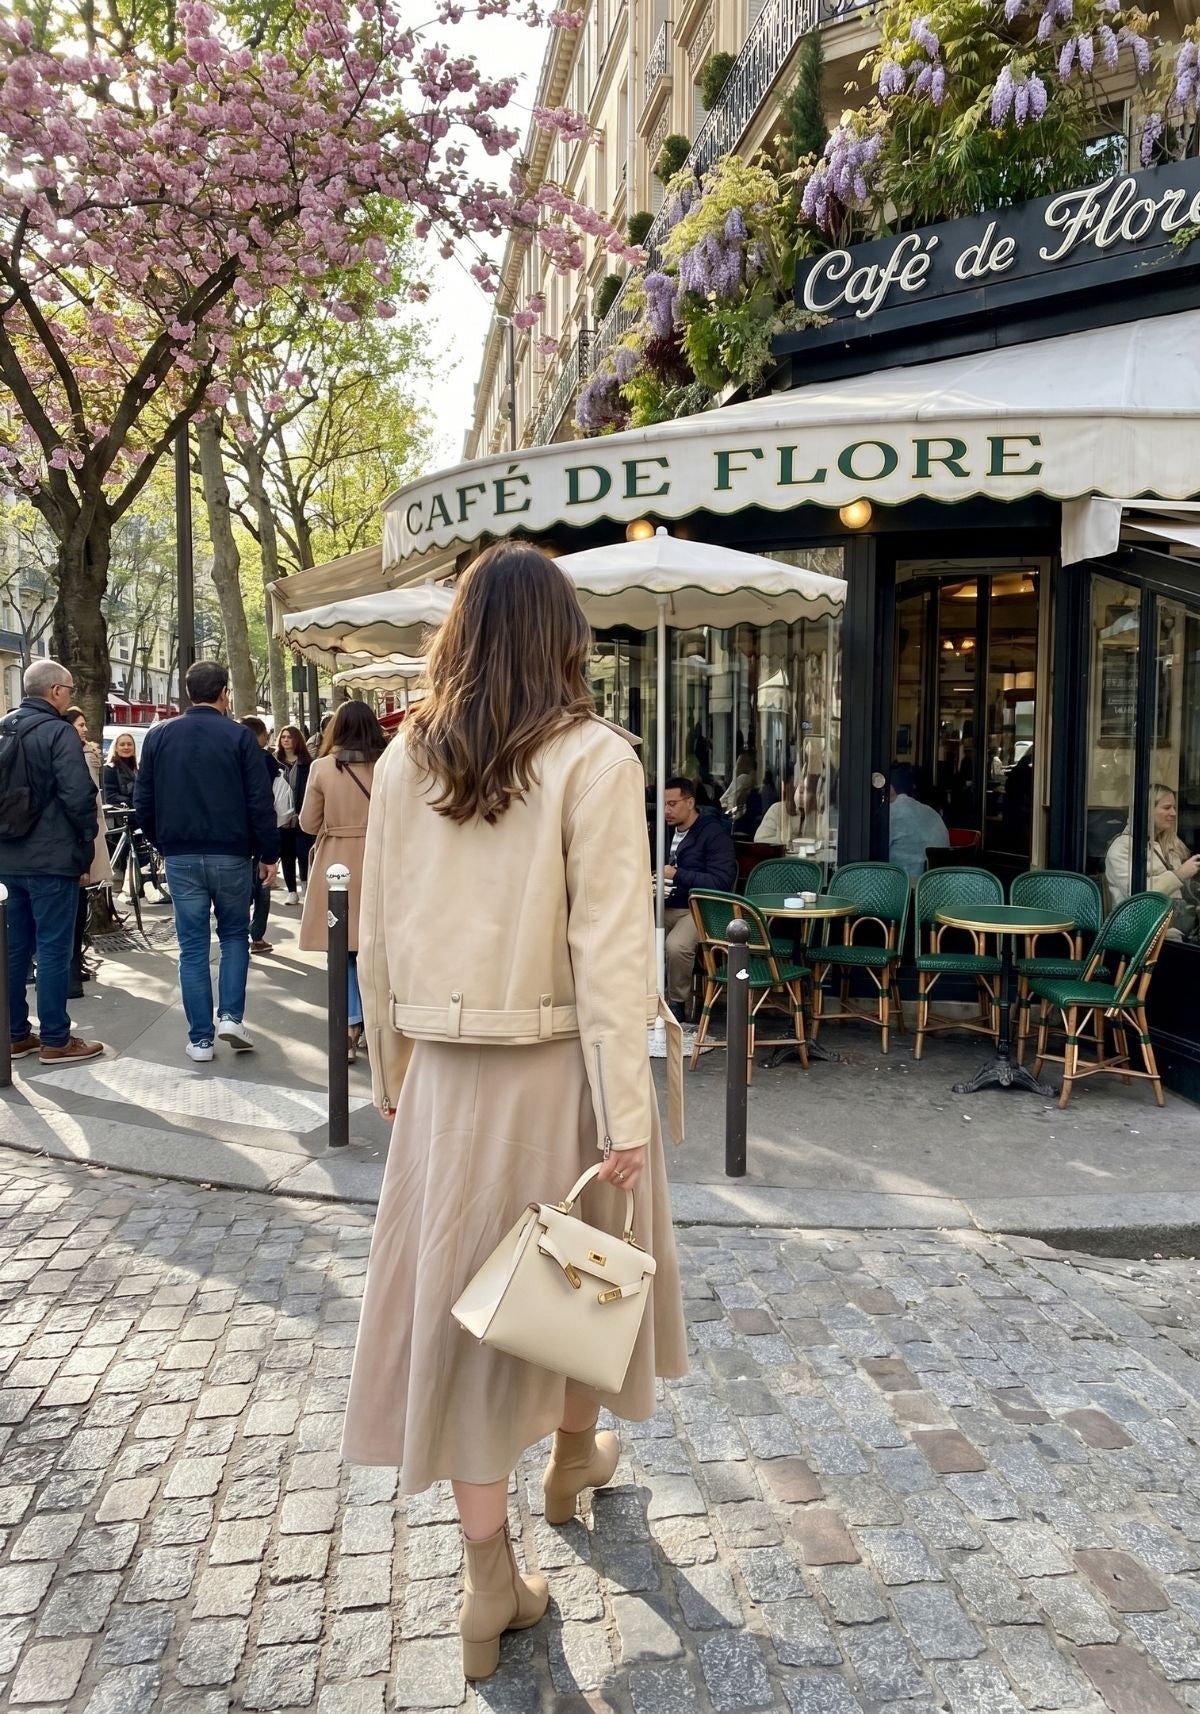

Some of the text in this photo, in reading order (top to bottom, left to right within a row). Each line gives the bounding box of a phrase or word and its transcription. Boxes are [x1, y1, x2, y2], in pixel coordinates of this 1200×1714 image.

[803, 233, 939, 319] Café
[954, 221, 1016, 281] de
[405, 434, 1045, 536] CAFÉ DE FLORE
